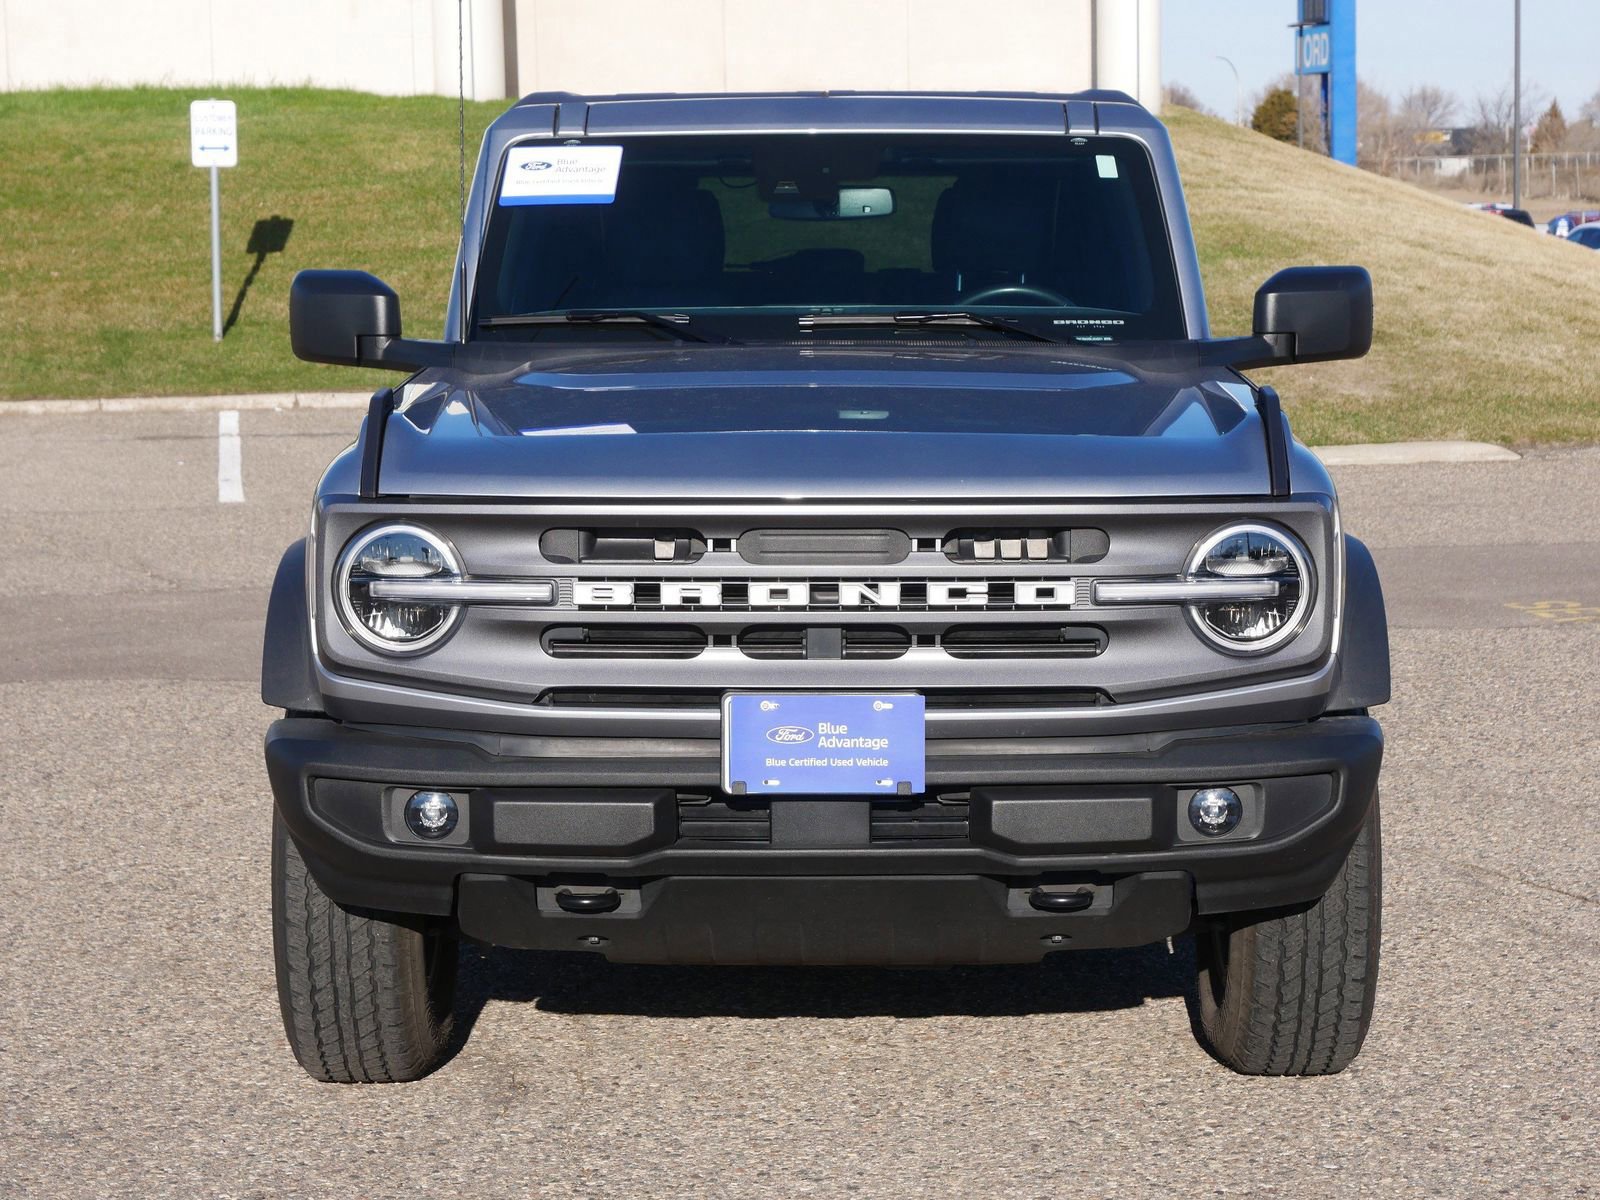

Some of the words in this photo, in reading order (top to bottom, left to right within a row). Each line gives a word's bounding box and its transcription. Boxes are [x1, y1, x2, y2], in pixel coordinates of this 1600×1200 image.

[194, 127, 233, 136] PARKING
[555, 166, 606, 174] Advantage
[572, 582, 1076, 605] BRONCO
[818, 723, 848, 734] Blue
[818, 736, 889, 750] Advantage
[765, 758, 786, 766] Blue
[789, 757, 827, 766] Certified
[830, 758, 853, 766] Used
[856, 758, 888, 766] Vehicle
